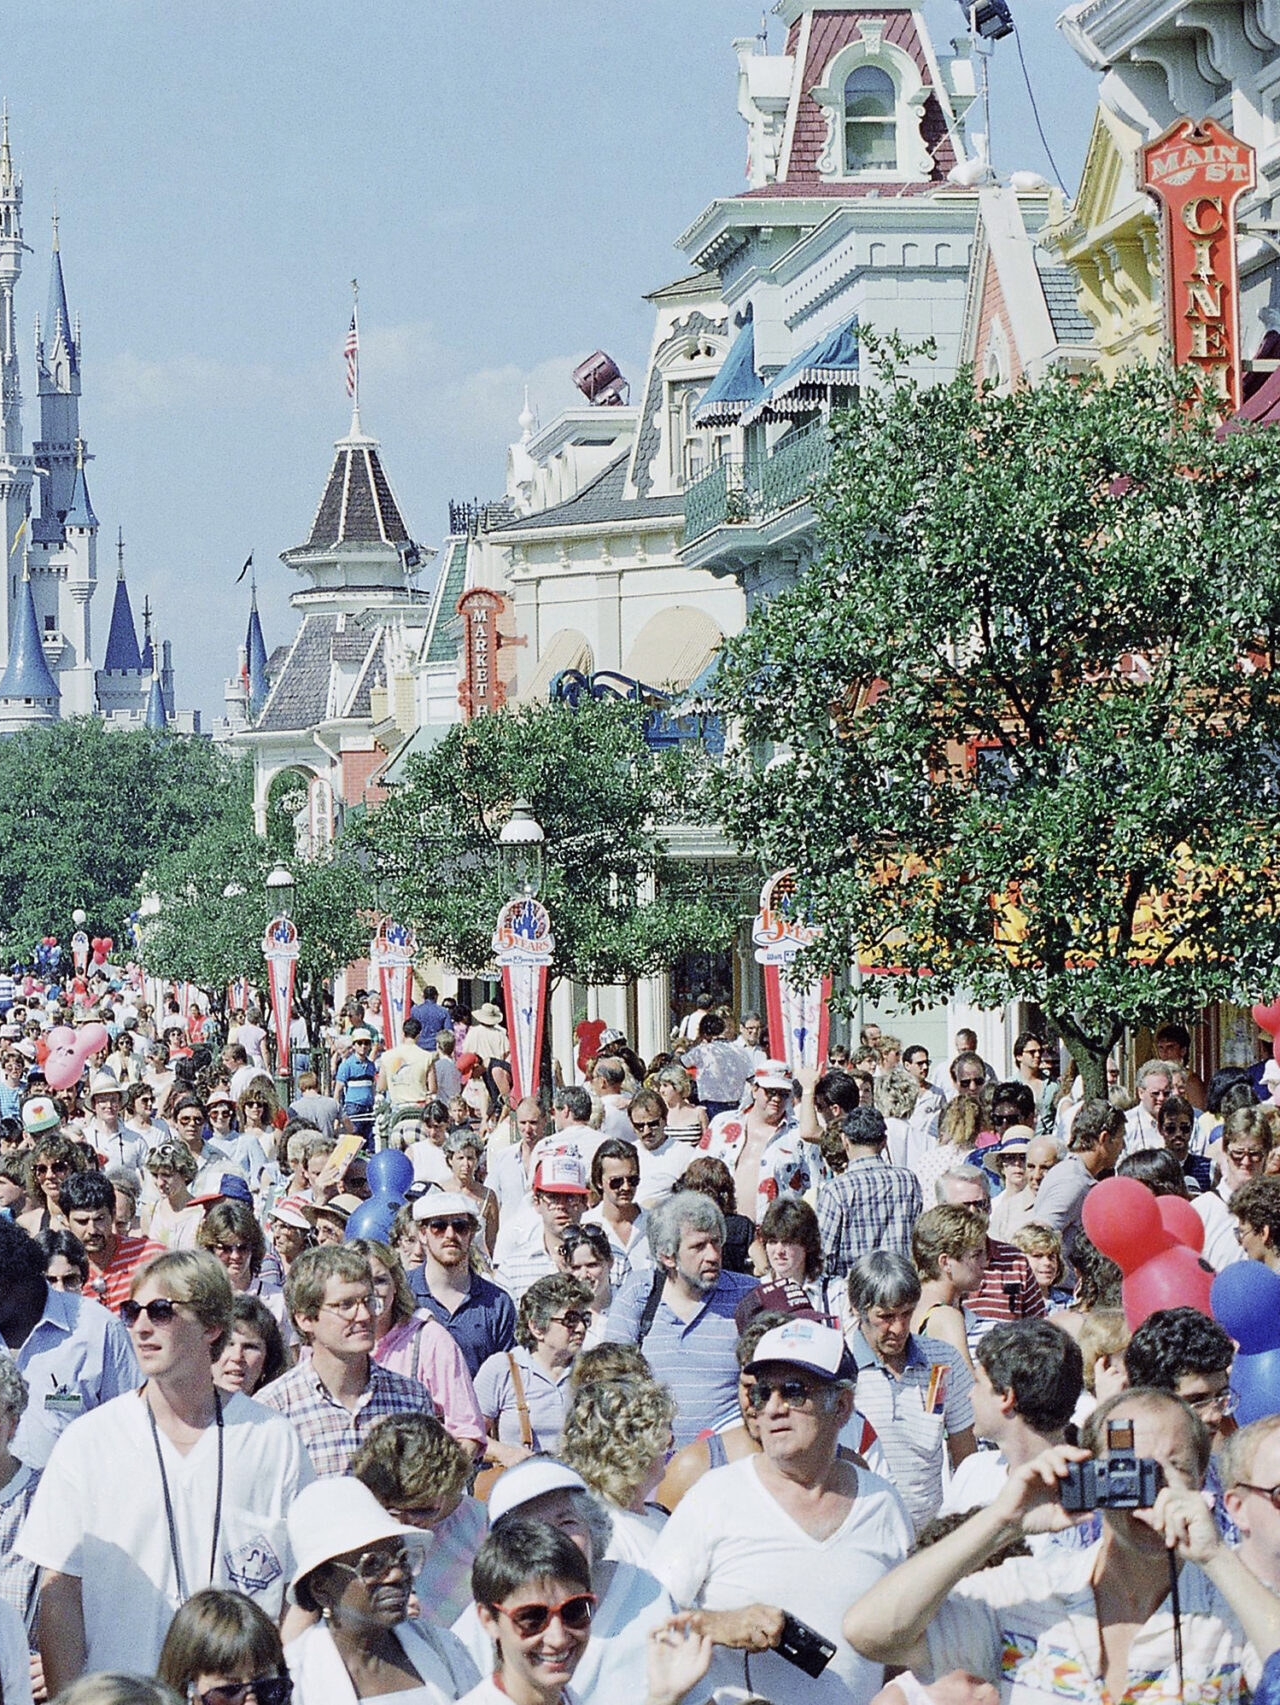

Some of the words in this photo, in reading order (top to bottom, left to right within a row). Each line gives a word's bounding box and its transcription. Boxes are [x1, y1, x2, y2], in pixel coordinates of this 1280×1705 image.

[1150, 145, 1239, 181] MAIN
[1204, 162, 1250, 182] ST.
[473, 609, 489, 698] MARKET
[375, 937, 388, 954] 15
[498, 927, 514, 949] 15
[514, 935, 550, 952] YEARS
